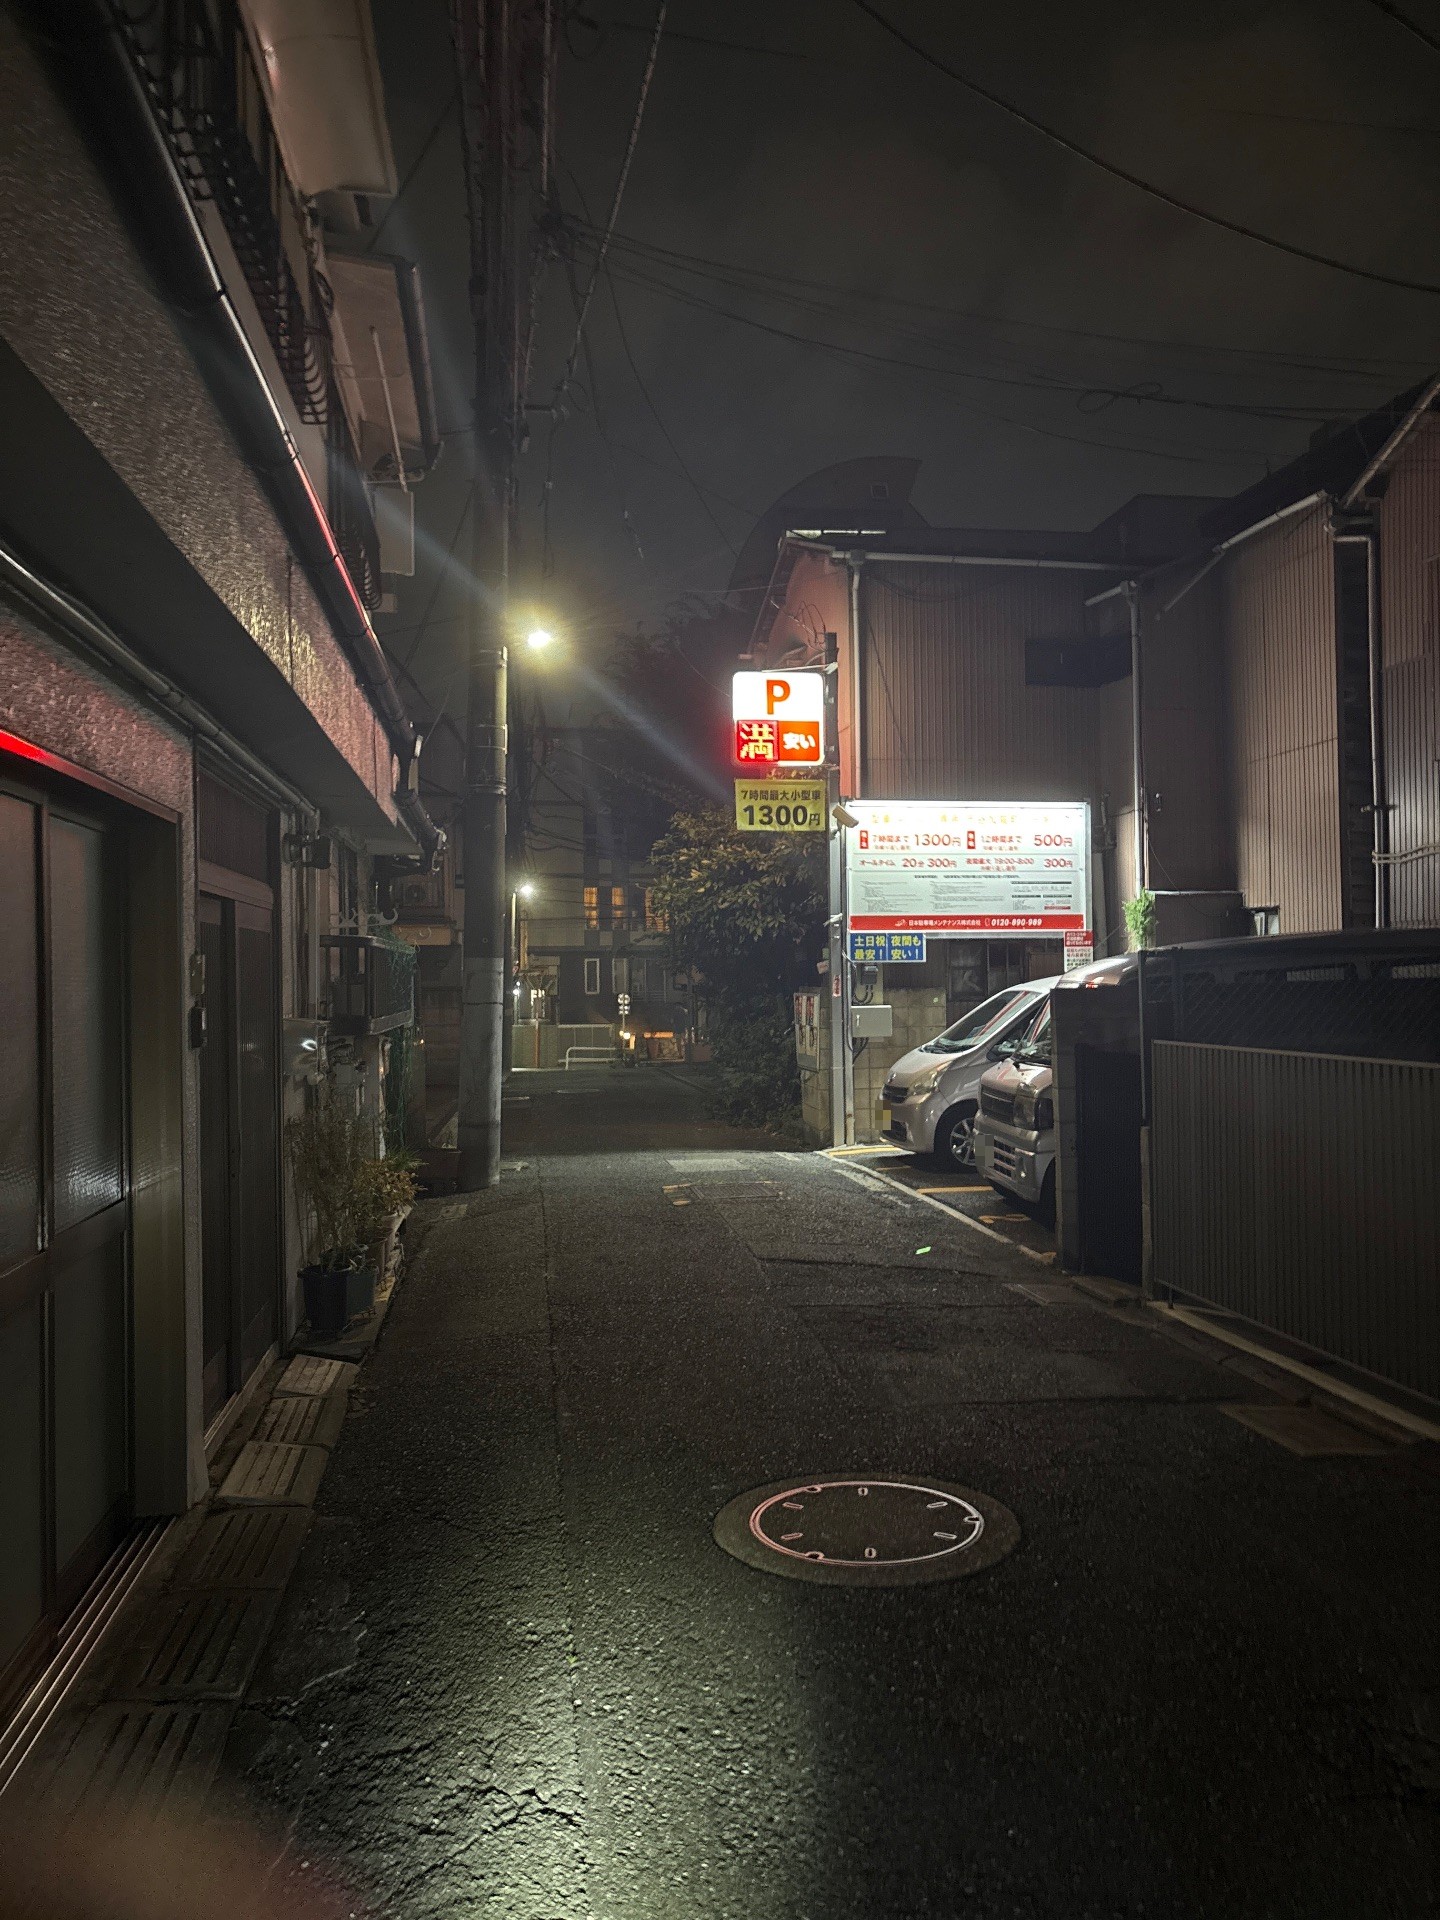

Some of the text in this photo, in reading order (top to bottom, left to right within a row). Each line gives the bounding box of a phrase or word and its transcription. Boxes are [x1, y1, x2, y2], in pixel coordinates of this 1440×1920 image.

[766, 680, 791, 715] P
[740, 723, 775, 761] 満
[783, 732, 816, 750] 安い
[741, 790, 821, 801] 7時間最大小型車
[743, 804, 820, 826] 1300円
[914, 834, 961, 847] 1300円
[1034, 834, 1073, 847] 500円
[1044, 858, 1073, 868] 300円
[854, 935, 886, 947] 土日祝
[891, 935, 922, 947] 夜間も
